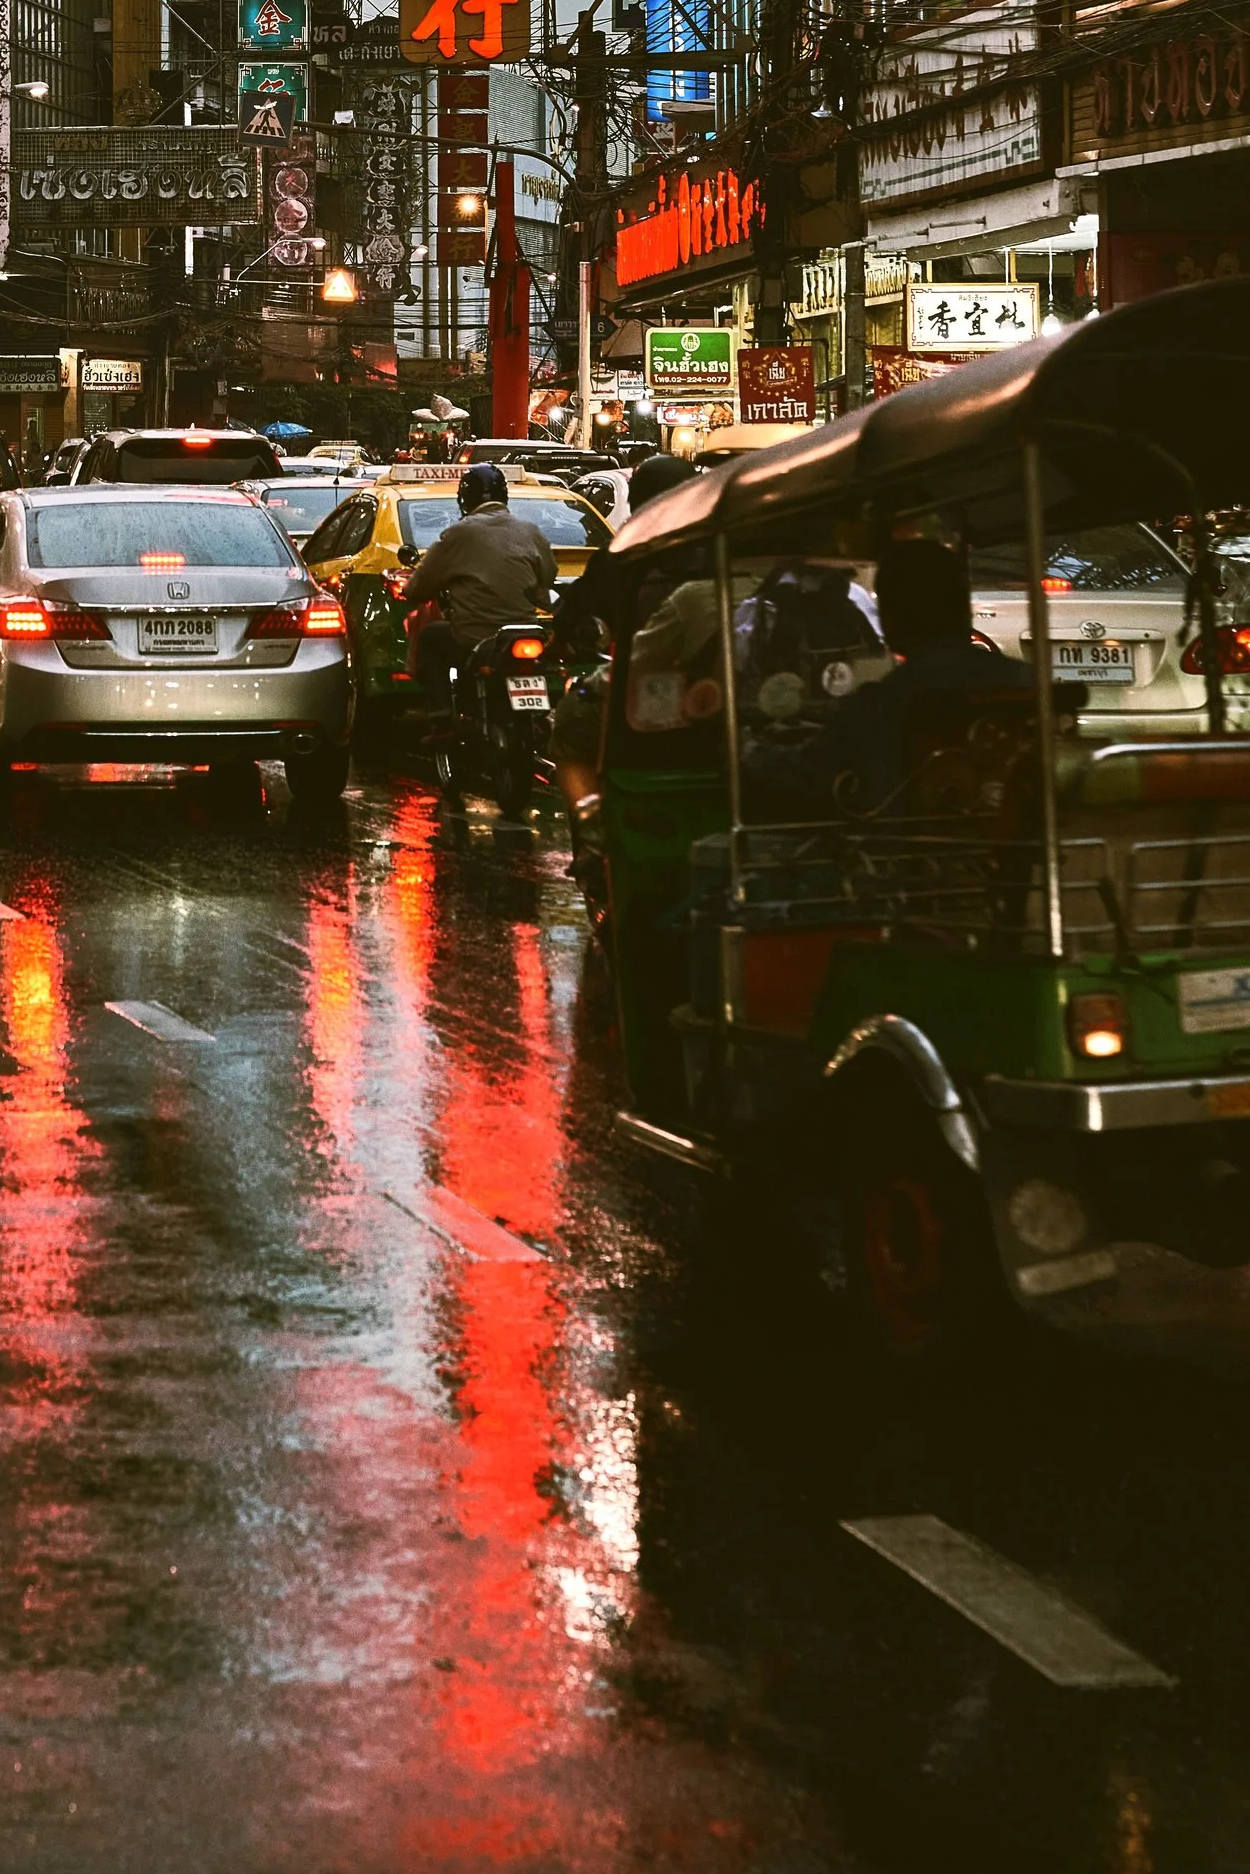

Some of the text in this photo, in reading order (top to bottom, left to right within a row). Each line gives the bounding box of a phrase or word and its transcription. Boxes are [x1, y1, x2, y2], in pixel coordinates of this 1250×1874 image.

[19, 147, 251, 200] เซ่งเฮงหลี
[597, 321, 605, 333] 6
[652, 352, 729, 373] จินฮั้วเฮง
[747, 396, 808, 420] เกาลัด
[178, 620, 212, 635] 2088
[1090, 647, 1129, 664] 9381
[518, 697, 543, 707] 302
